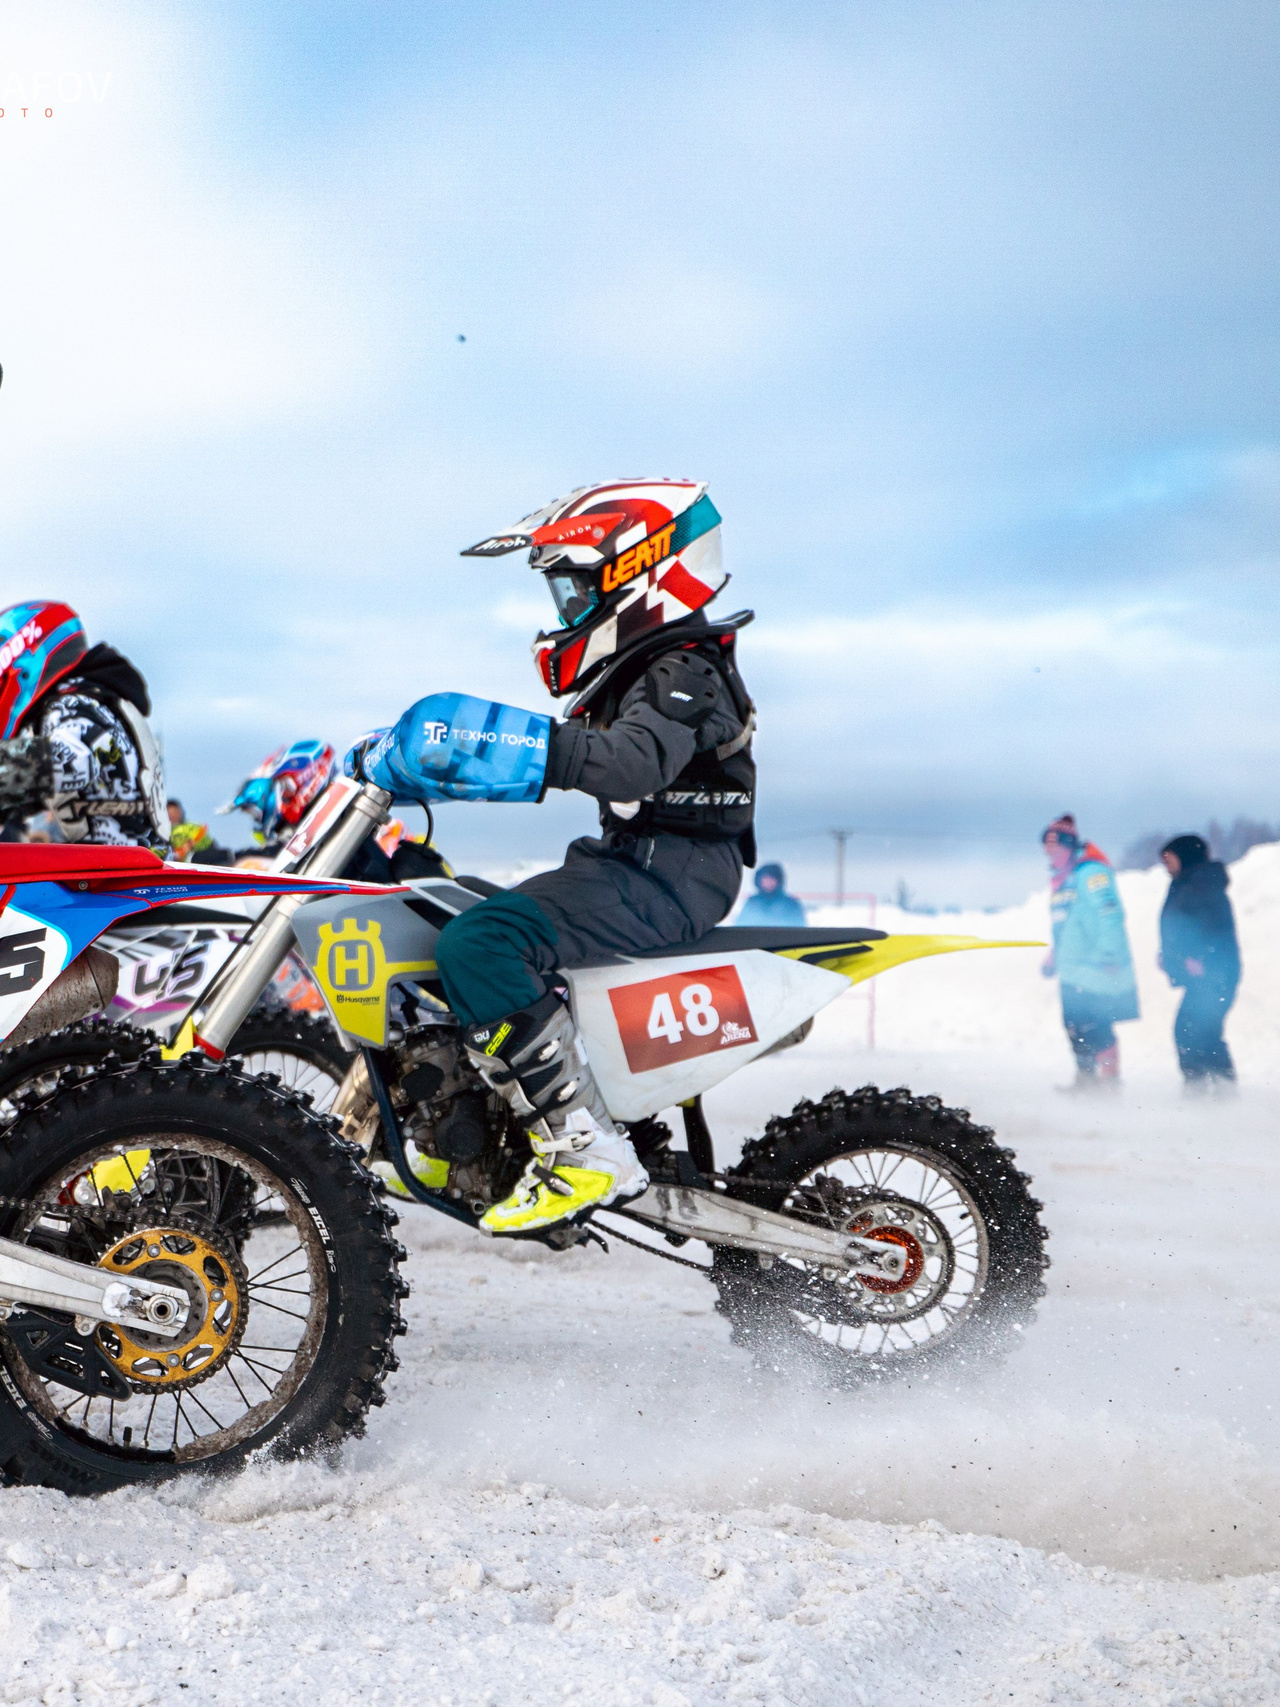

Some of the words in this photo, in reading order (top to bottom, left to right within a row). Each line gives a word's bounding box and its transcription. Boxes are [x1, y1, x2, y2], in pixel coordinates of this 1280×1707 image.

[474, 536, 527, 551] Airoh
[558, 525, 592, 541] AIROH
[602, 522, 676, 592] LEATT
[452, 729, 497, 743] ТЕХНО
[501, 733, 547, 749] ГОРОД
[344, 995, 380, 1003] Husqvarna
[647, 983, 720, 1044] 48
[308, 1206, 330, 1245] EXCEL
[0, 1365, 27, 1410] EXCEL
